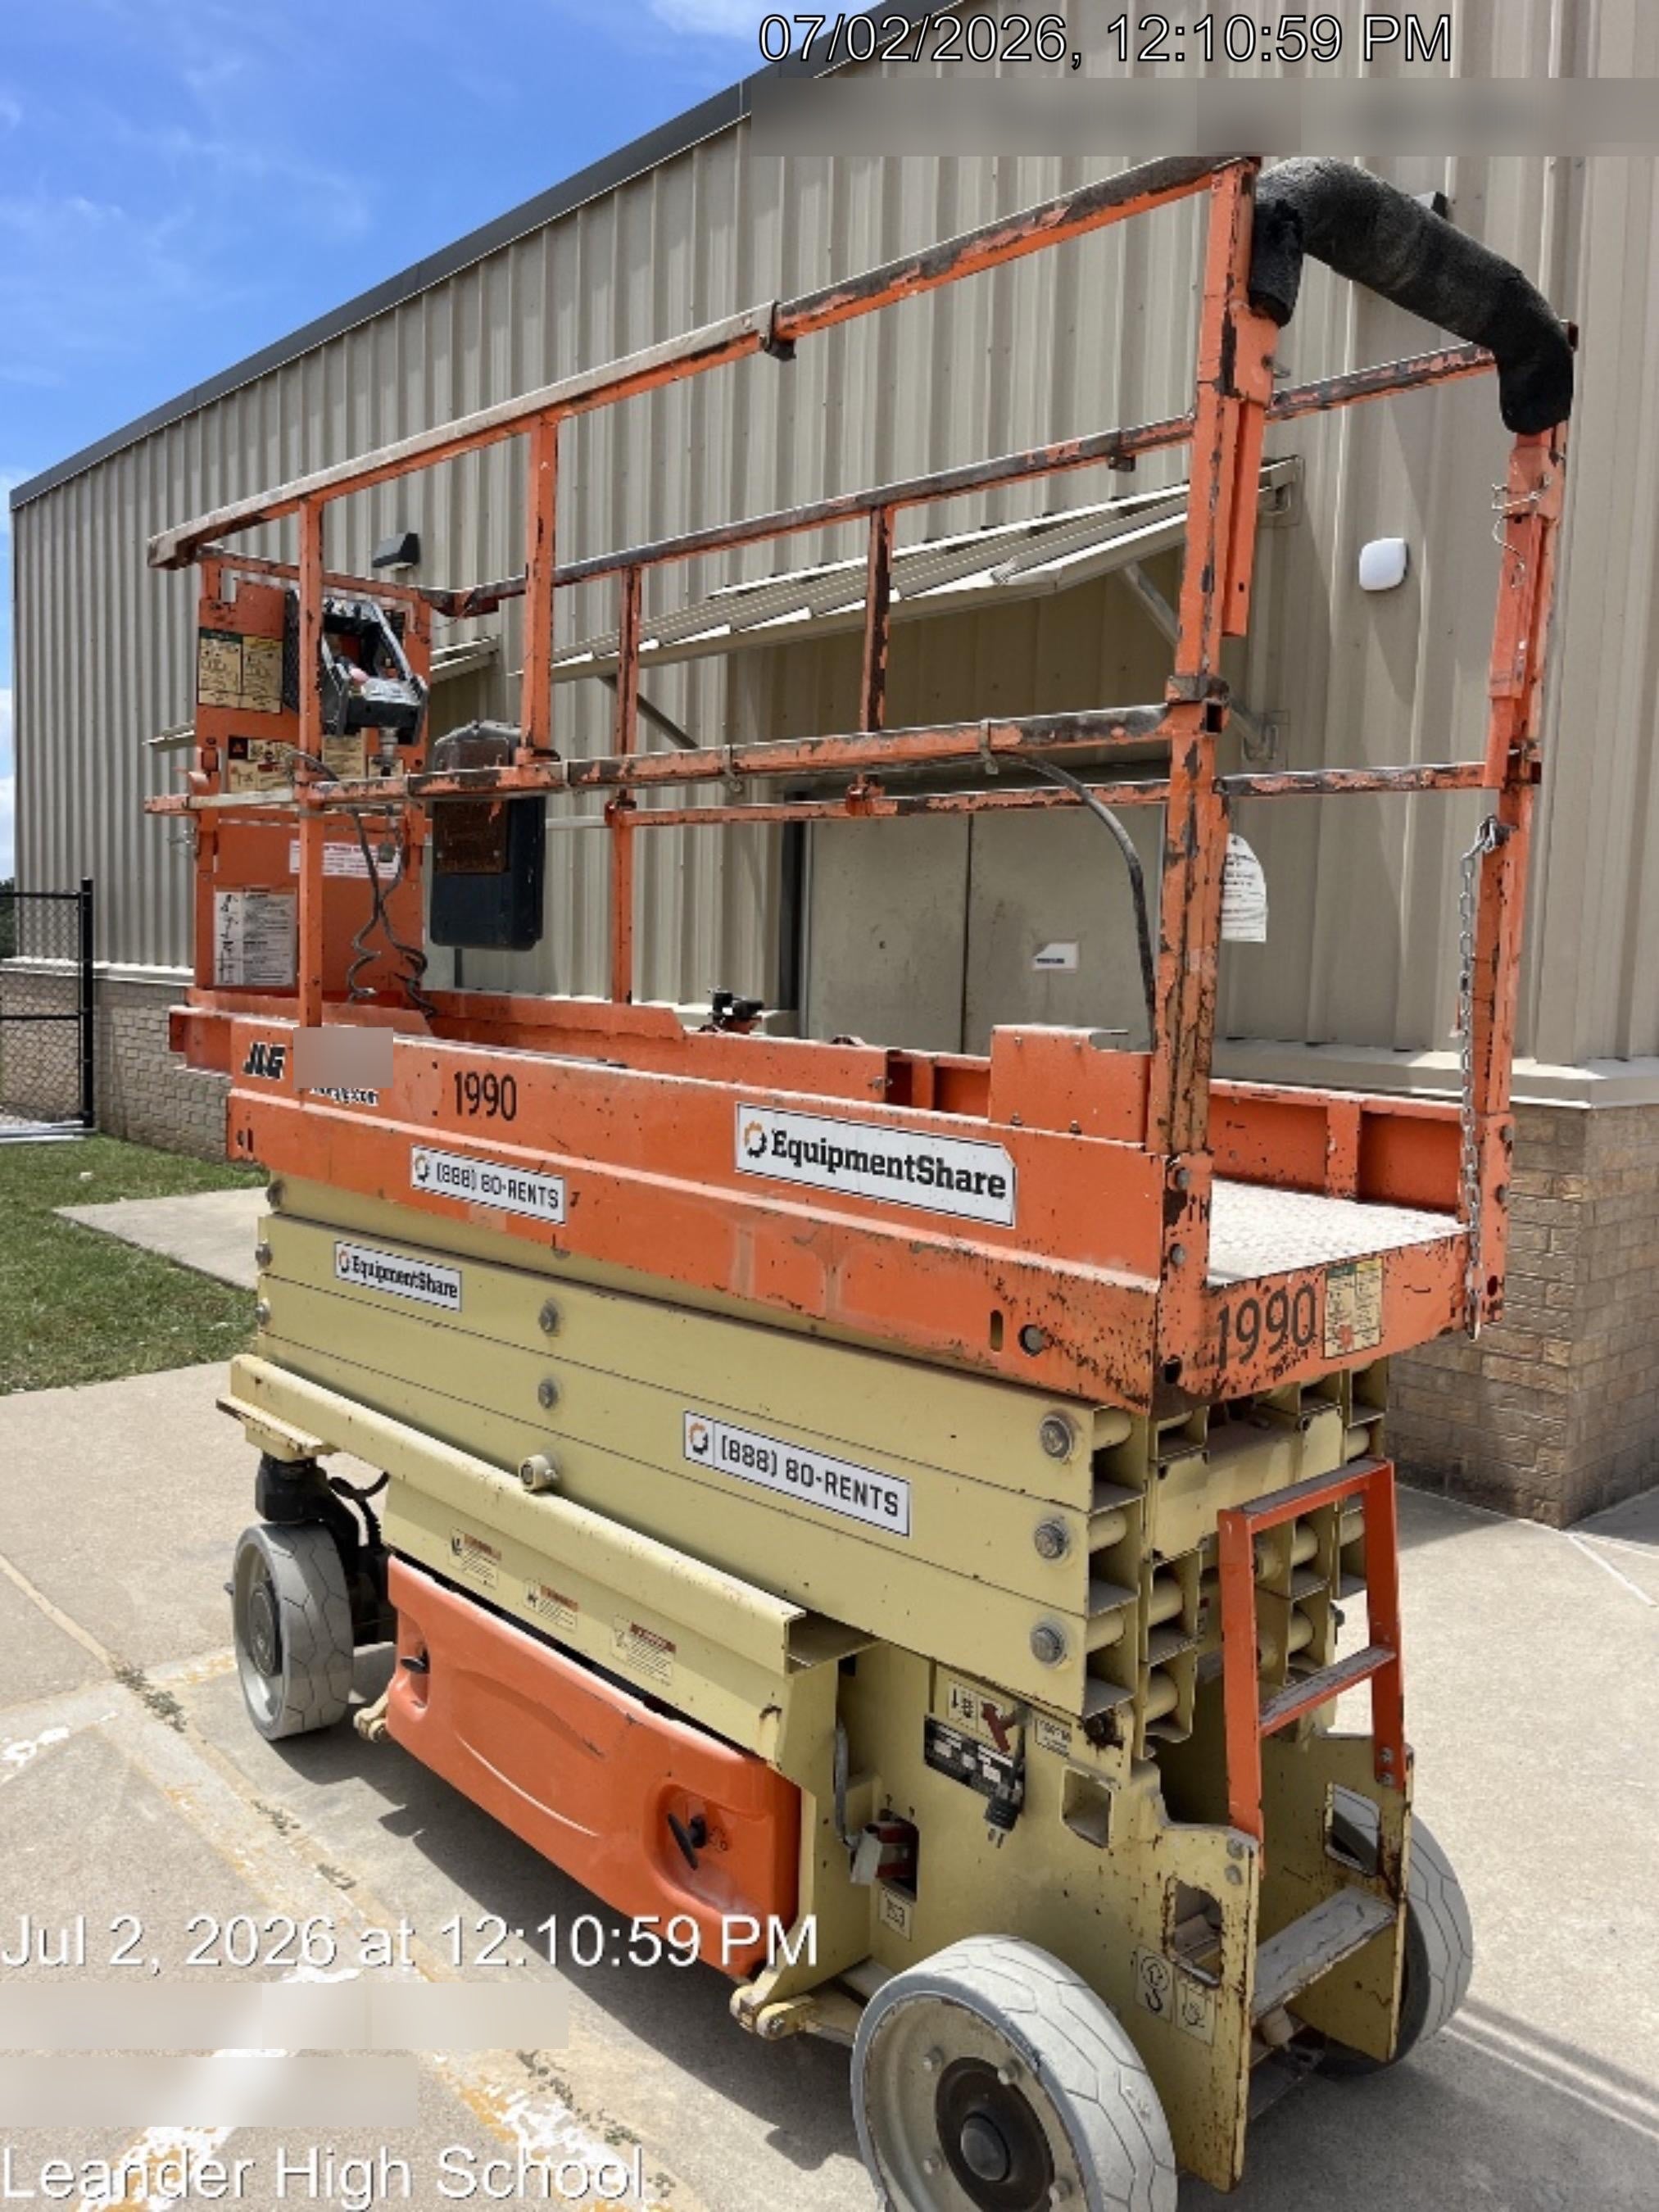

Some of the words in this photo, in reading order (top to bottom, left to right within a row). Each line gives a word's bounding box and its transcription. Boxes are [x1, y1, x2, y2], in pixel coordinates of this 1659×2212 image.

[244, 1042, 285, 1080] JLG
[455, 1071, 518, 1122] 1990
[437, 1162, 477, 1191] (888)
[481, 1174, 560, 1209] 80-RENTS
[771, 1129, 1007, 1199] EquipmentShare
[352, 1255, 458, 1299] EquipmentShare
[1218, 1285, 1317, 1371] 1990
[722, 1435, 777, 1477] (888)
[786, 1457, 899, 1517] 80-RENTS
